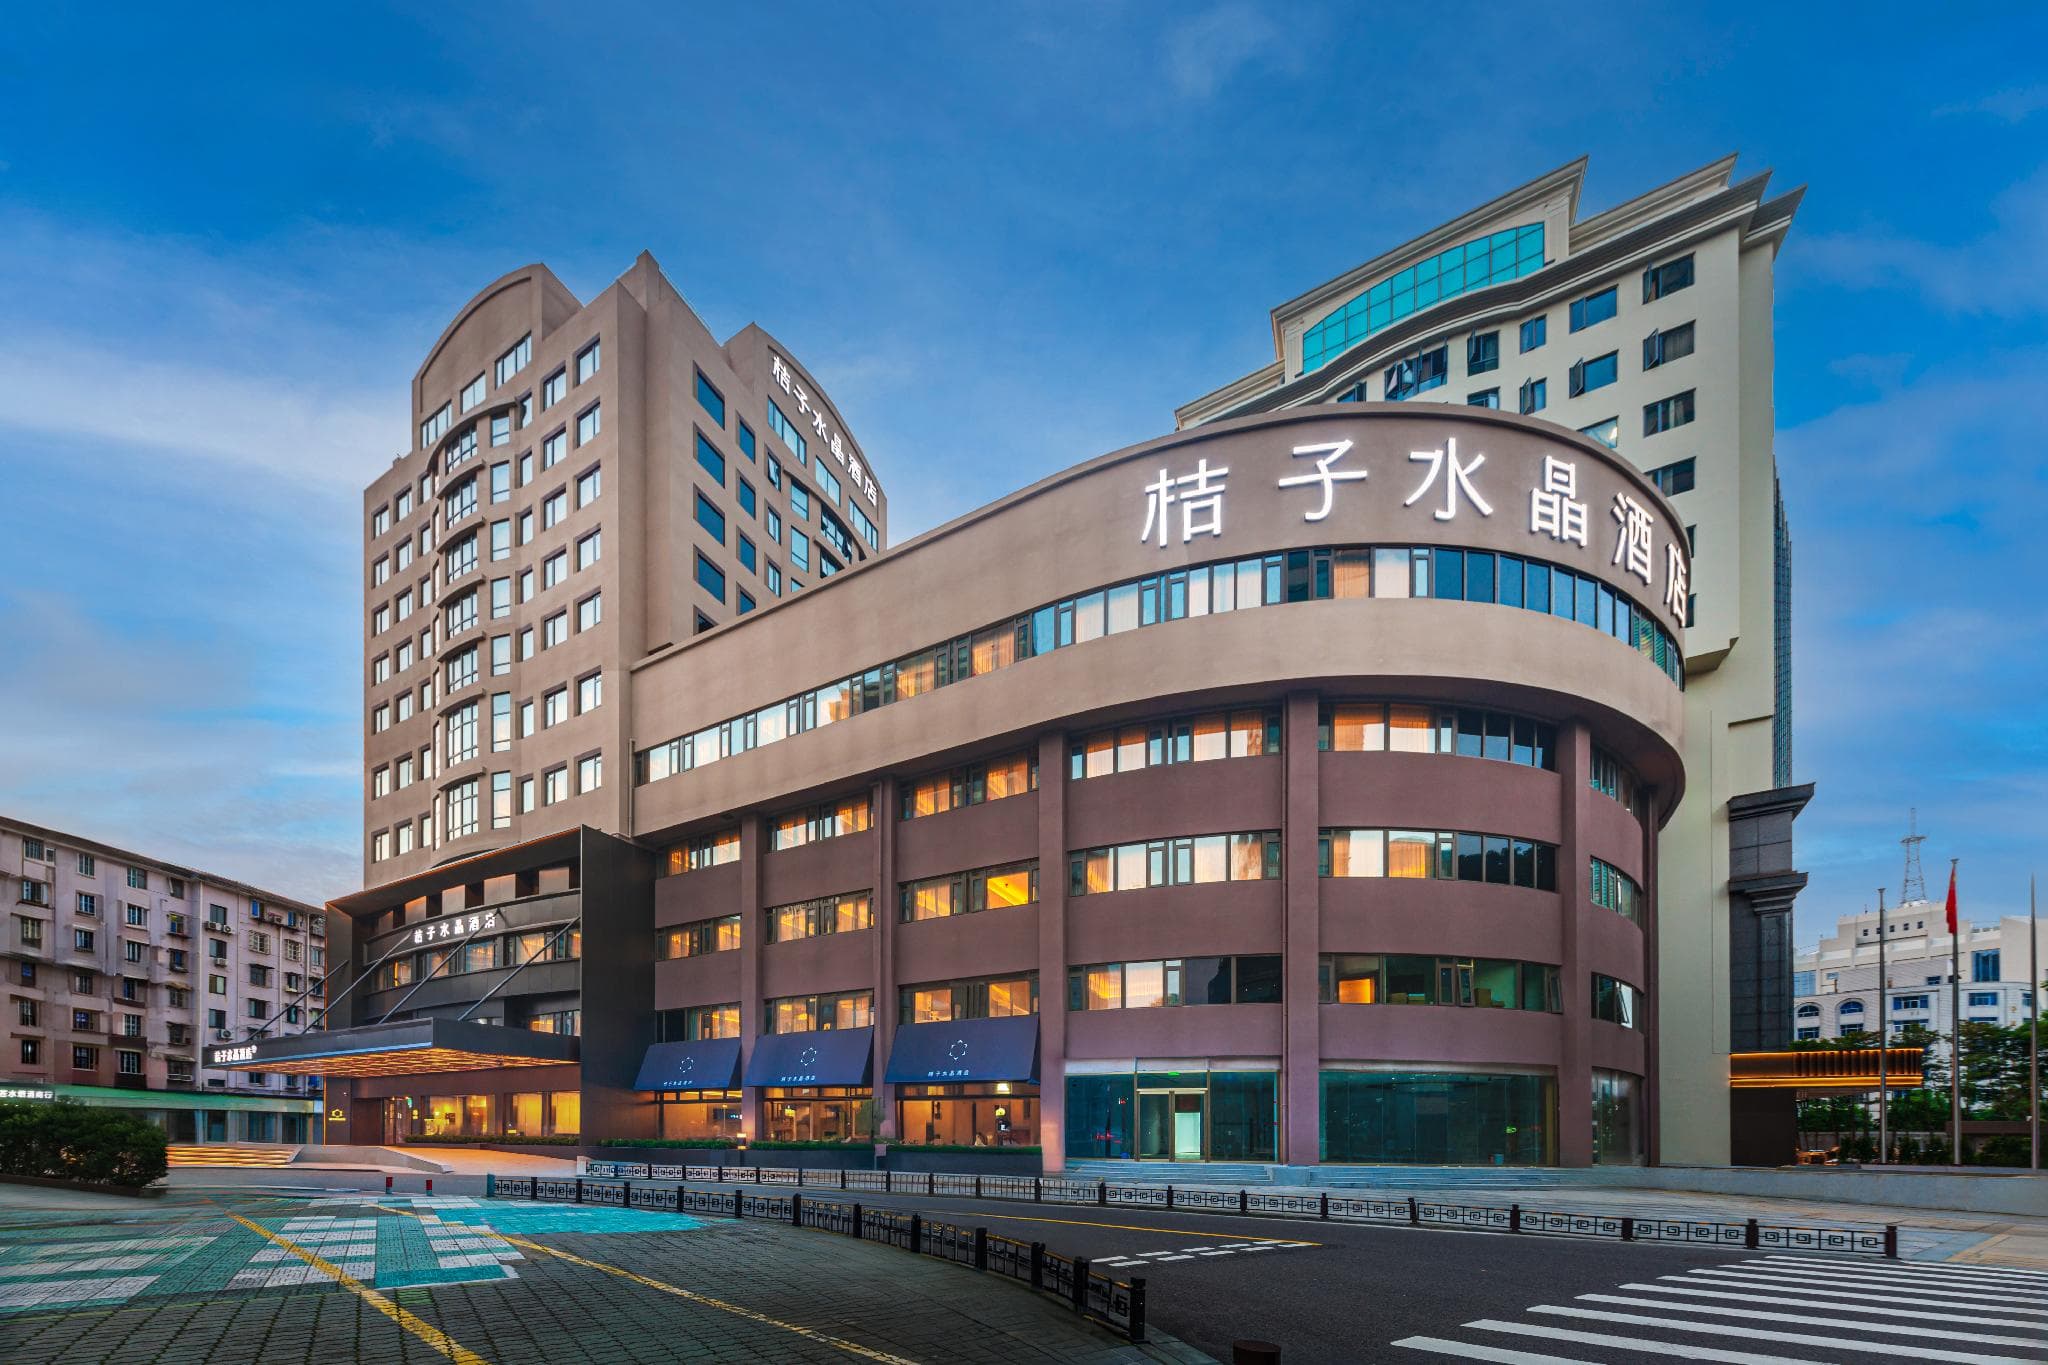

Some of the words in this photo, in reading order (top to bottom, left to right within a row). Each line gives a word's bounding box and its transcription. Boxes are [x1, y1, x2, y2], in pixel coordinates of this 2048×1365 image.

[772, 356, 877, 506] 桔子水晶酒店
[1141, 437, 1686, 628] 桔子水晶酒店
[414, 912, 496, 944] 桔子水晶酒店
